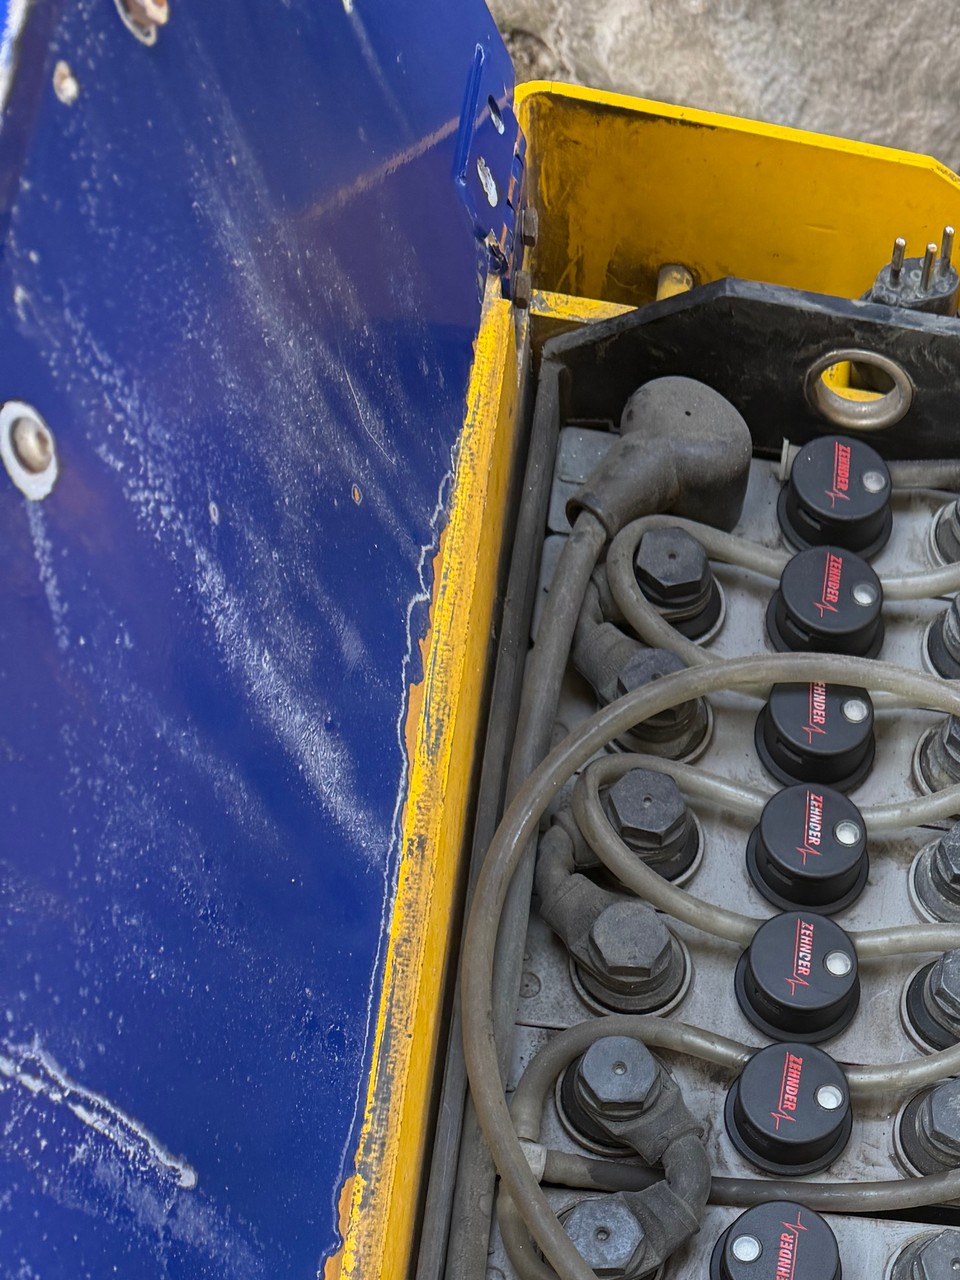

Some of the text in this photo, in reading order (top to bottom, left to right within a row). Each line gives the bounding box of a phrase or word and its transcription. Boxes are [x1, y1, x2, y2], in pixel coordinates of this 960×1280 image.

[836, 443, 851, 491] ZEHNDER
[825, 554, 842, 603] ZEHNDER
[813, 682, 826, 725] EHNDER
[808, 792, 823, 846] ZEHNDER
[797, 921, 814, 976] ZEHNDER
[782, 1053, 803, 1110] ZEHNDER
